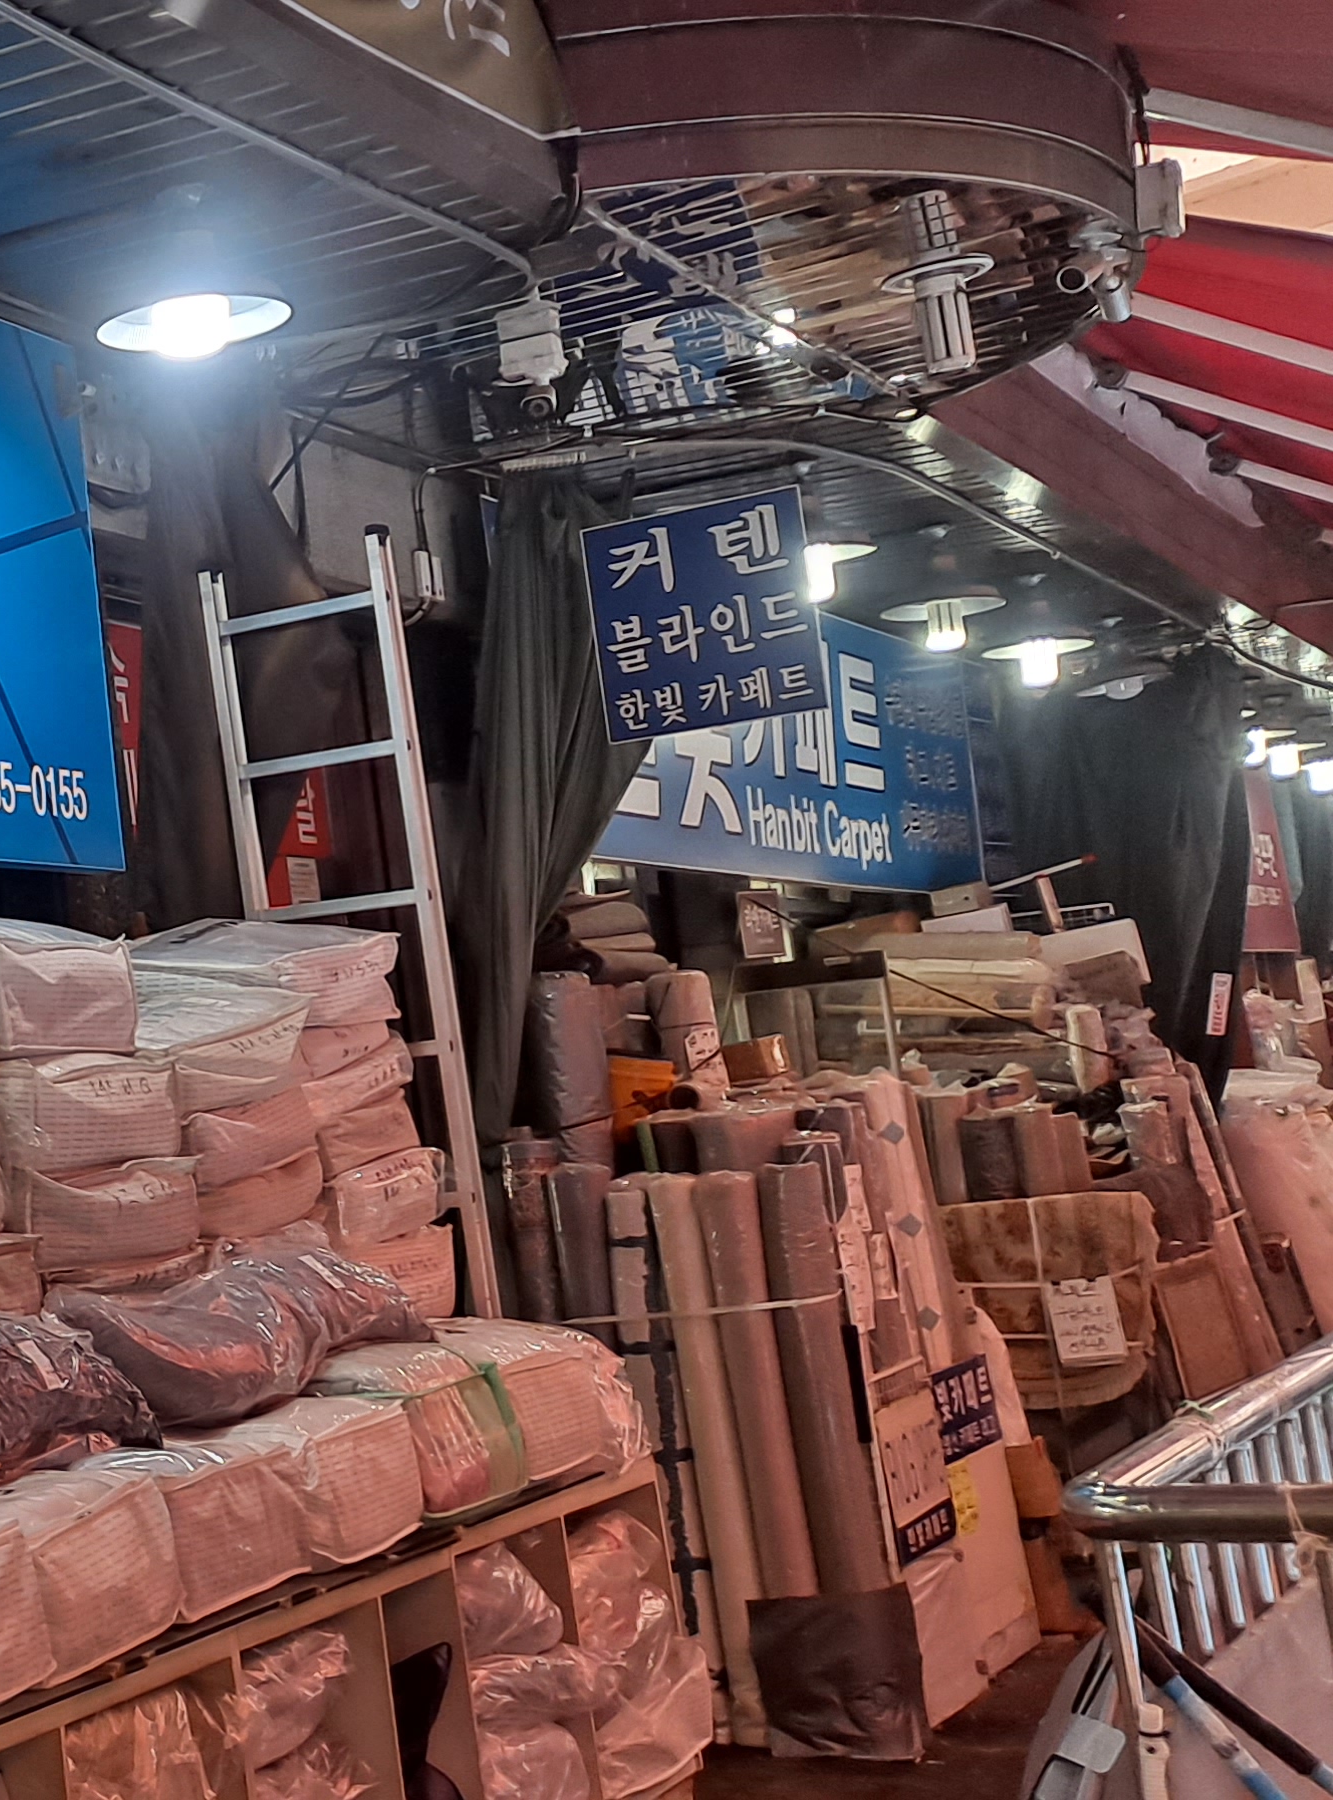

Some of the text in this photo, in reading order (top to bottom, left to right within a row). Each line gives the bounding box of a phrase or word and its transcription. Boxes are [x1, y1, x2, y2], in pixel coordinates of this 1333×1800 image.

[605, 590, 809, 674] 블라인드
[614, 664, 815, 732] 한빛 카페트
[744, 784, 822, 855] Hanbit
[823, 799, 894, 872] Carpet
